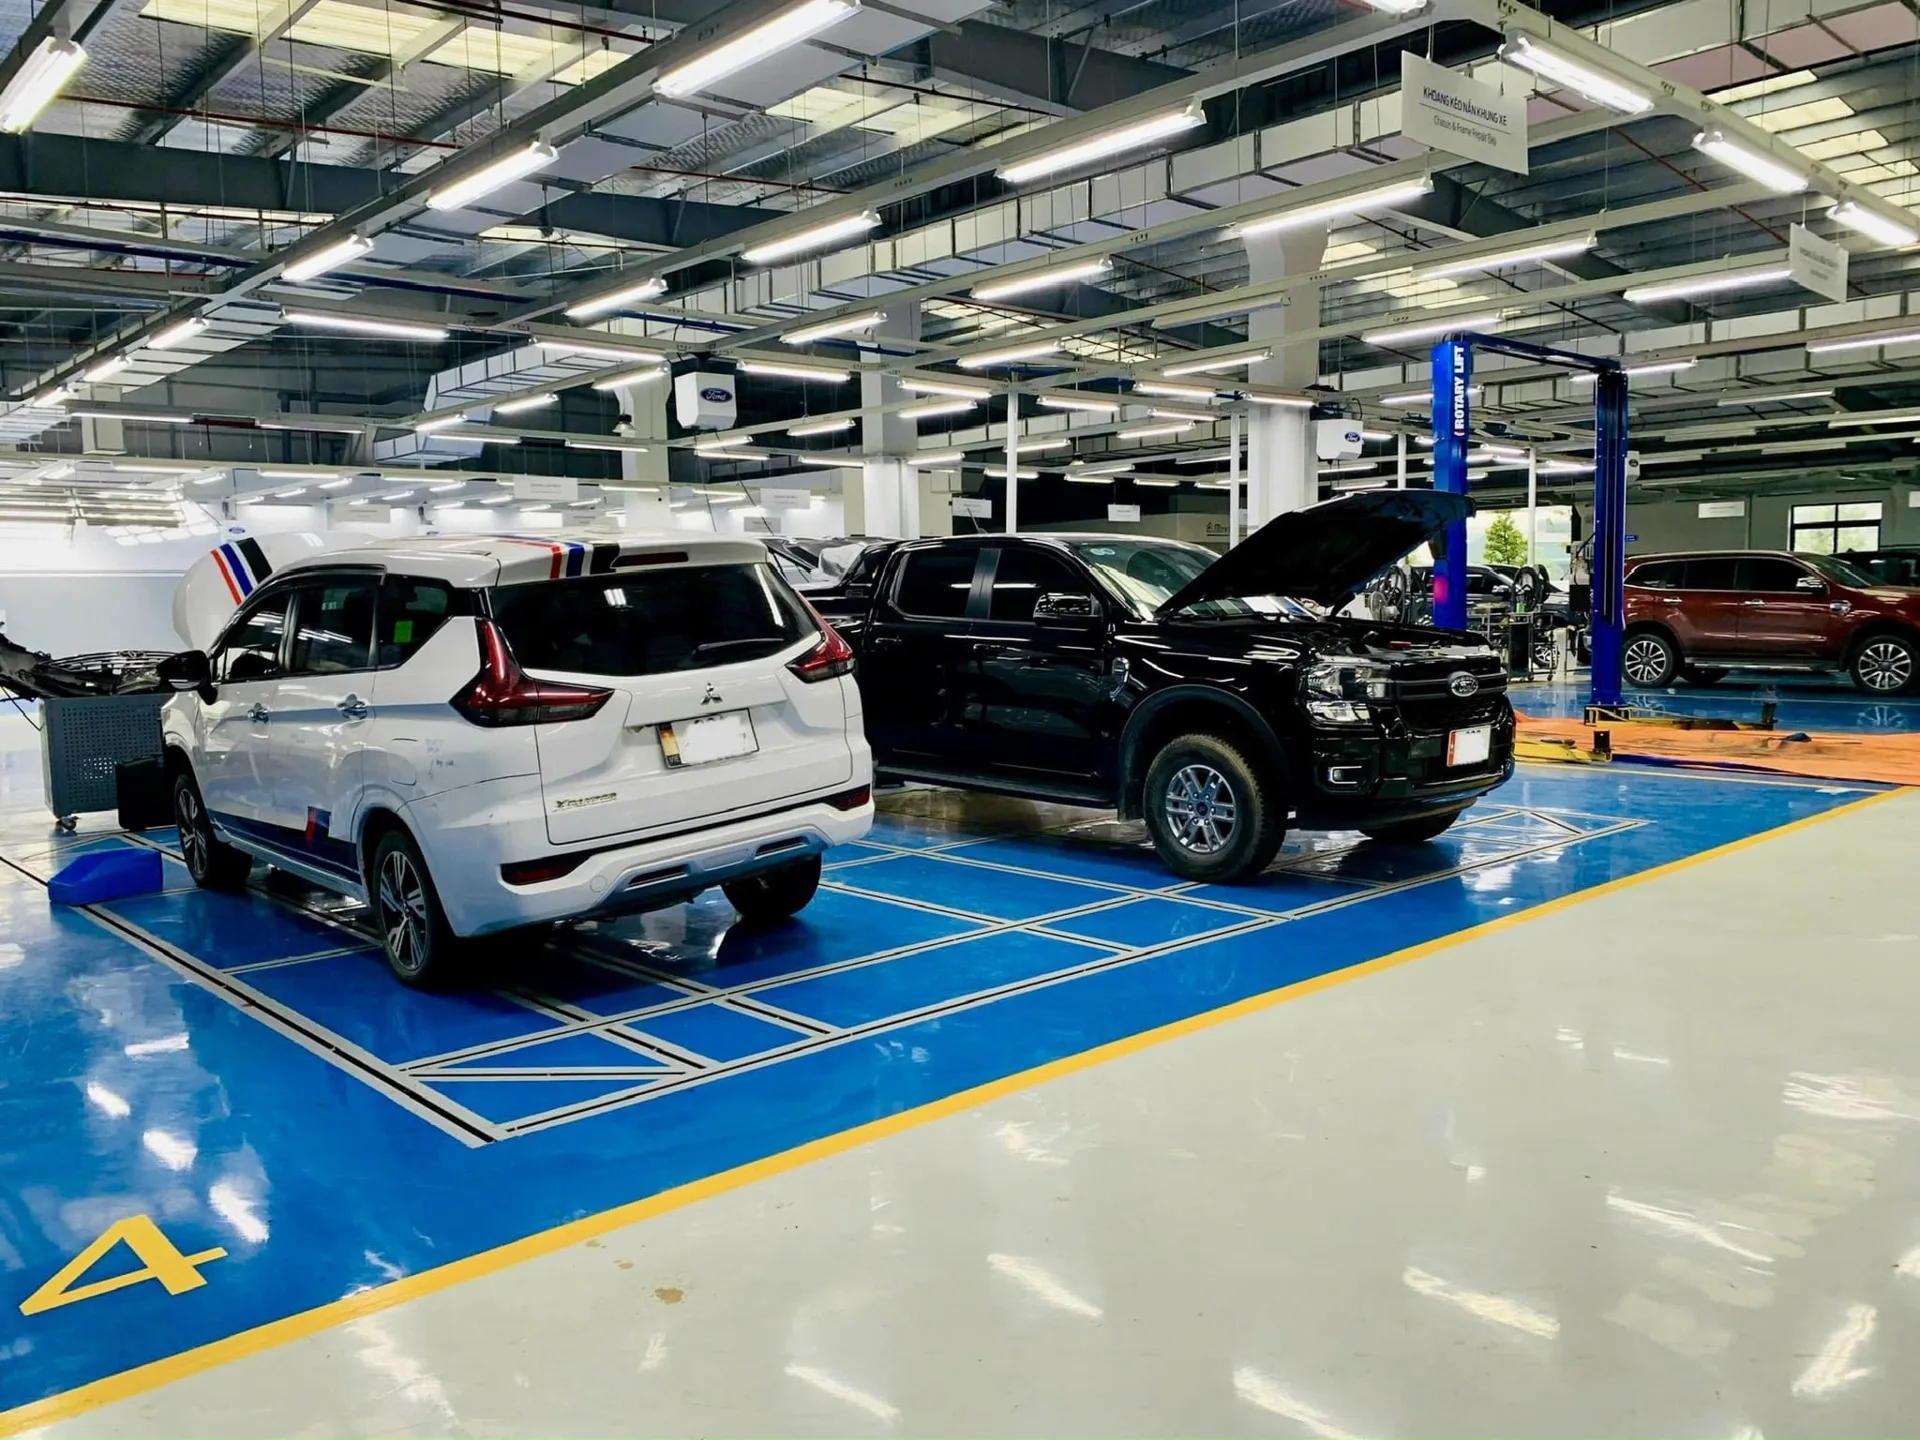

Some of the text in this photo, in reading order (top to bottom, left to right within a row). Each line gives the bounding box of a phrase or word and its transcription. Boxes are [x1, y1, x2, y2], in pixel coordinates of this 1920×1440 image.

[1423, 86, 1449, 106] KHOANG
[1476, 106, 1498, 124] KHUNG
[1498, 114, 1507, 126] XE
[704, 389, 729, 402] Ford
[1454, 345, 1465, 430] ROTARY LIFT
[19, 1214, 229, 1316] 4
